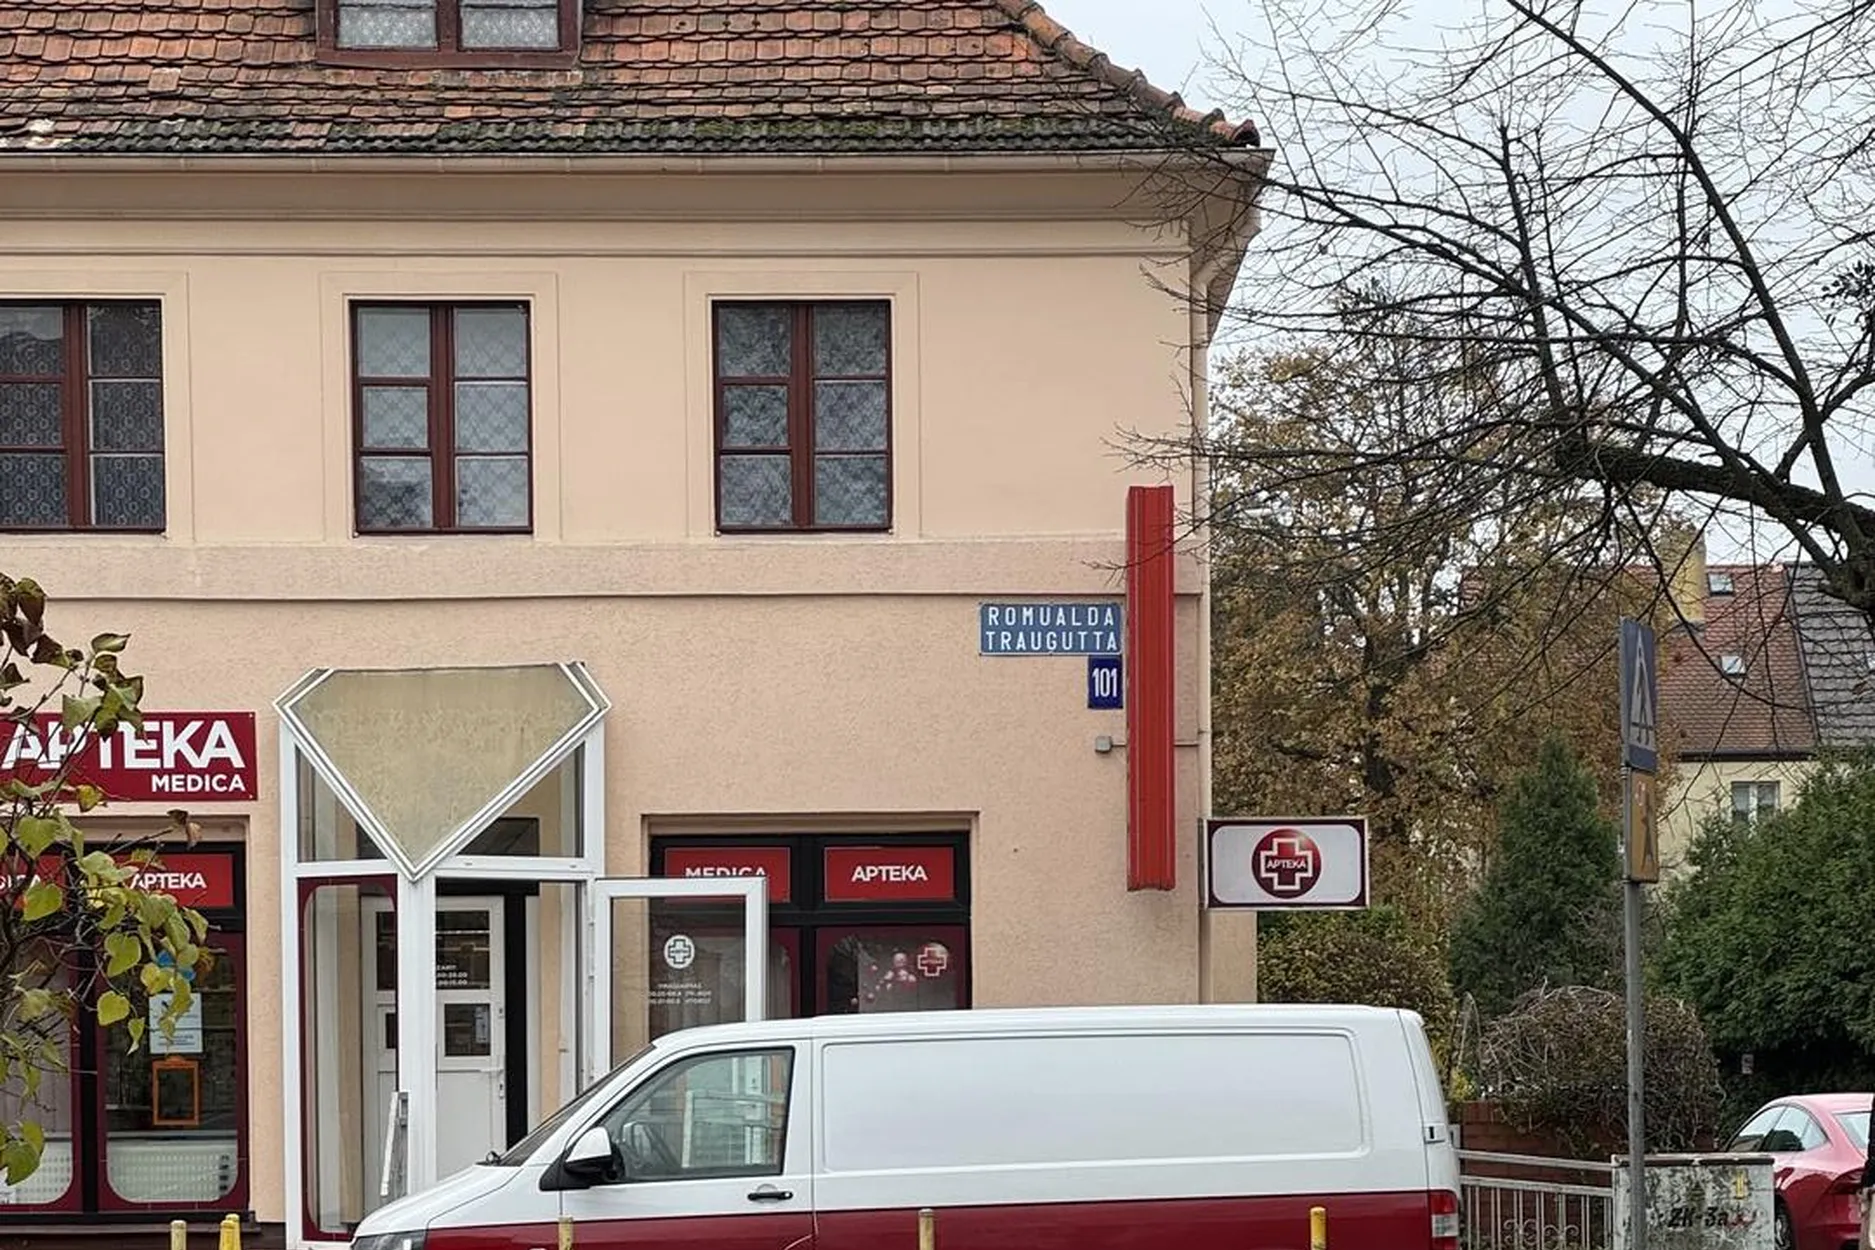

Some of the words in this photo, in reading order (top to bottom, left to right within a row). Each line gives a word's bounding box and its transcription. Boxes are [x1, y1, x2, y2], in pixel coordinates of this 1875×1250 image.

[988, 606, 1115, 627] ROMUALDA
[985, 631, 1118, 651] TRAUGUTTA
[1092, 667, 1118, 698] 101
[1, 719, 245, 770] APTEKA
[151, 774, 246, 793] MEDICA
[851, 864, 928, 883] APTEKA
[1266, 858, 1307, 870] APTEKA
[130, 872, 207, 890] APTEKA
